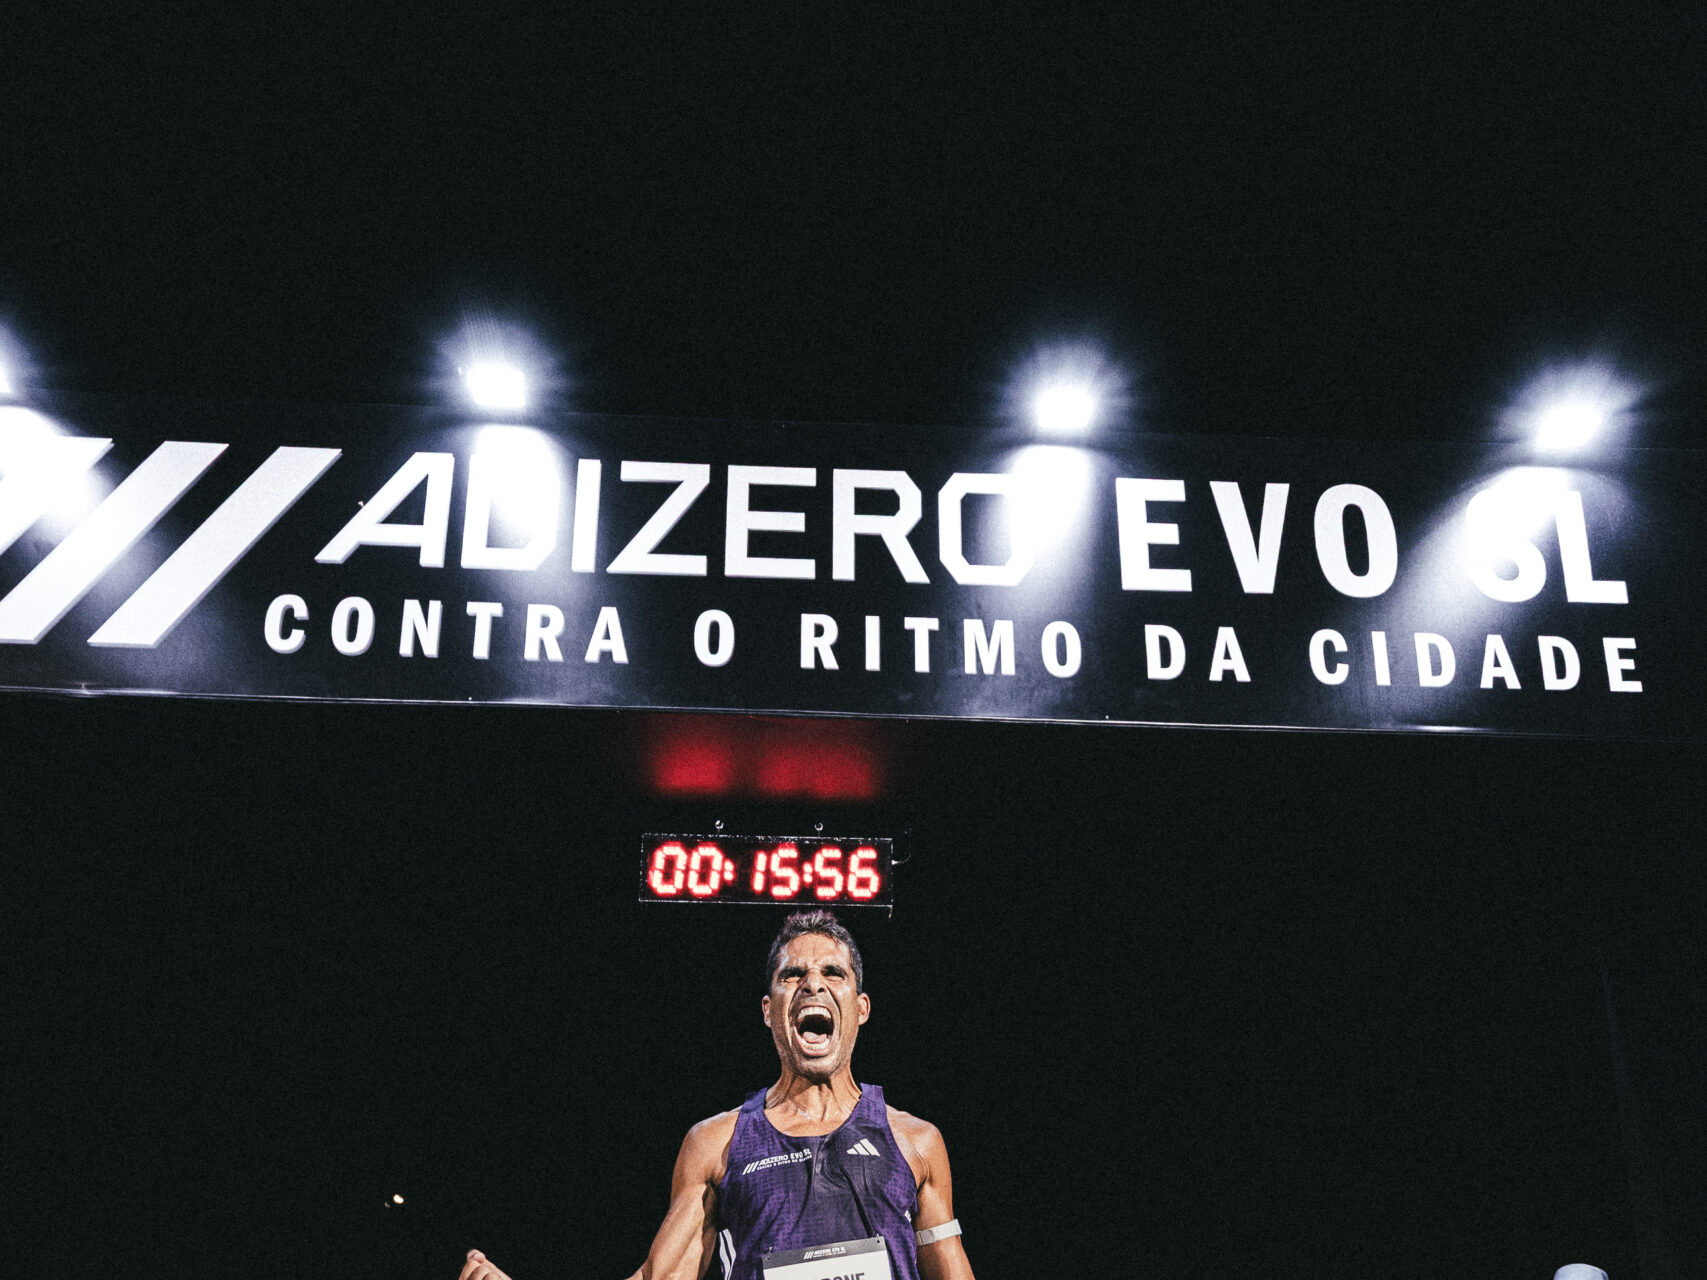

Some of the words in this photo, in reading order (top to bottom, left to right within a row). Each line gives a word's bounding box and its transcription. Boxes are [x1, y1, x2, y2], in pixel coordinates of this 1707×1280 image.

[314, 452, 1035, 587] ADIZERO
[1115, 477, 1398, 599] EVO
[264, 594, 630, 665] CONTRA
[694, 609, 736, 669] O
[801, 612, 1083, 680] RITMO
[1144, 624, 1251, 683] DA
[1308, 628, 1643, 694] CIDADE
